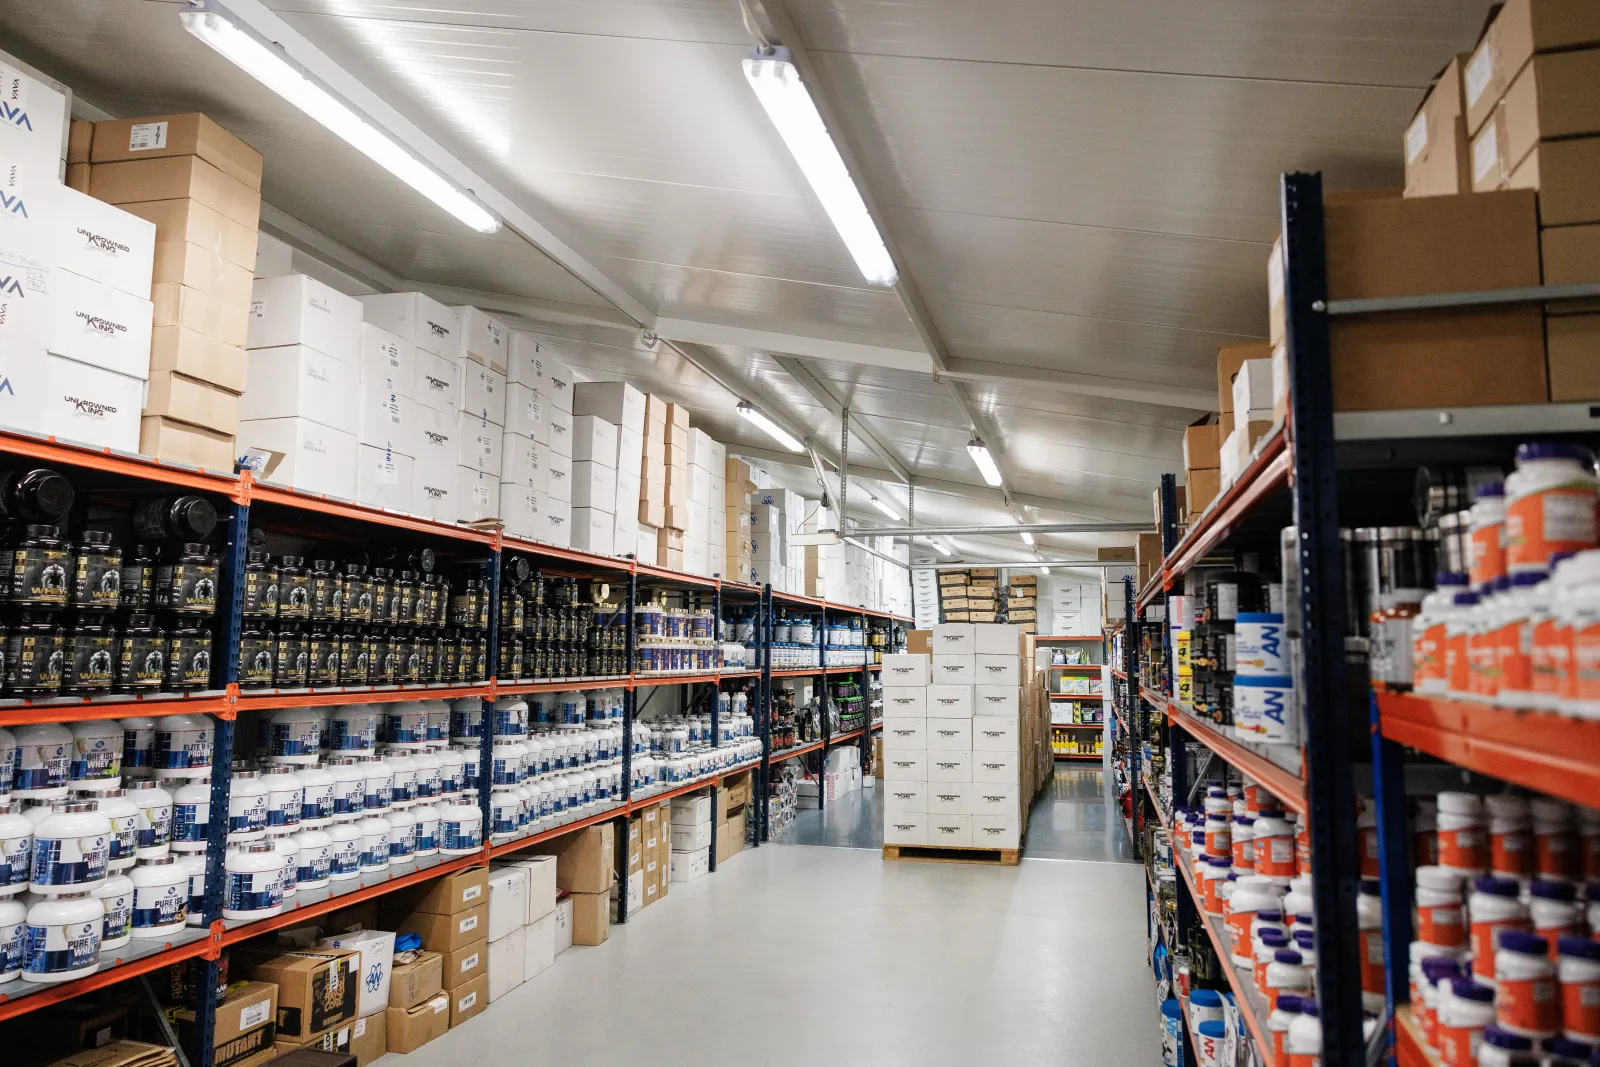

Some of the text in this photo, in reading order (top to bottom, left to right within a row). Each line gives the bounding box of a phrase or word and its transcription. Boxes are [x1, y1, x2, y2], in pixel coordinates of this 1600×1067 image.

[1261, 626, 1281, 659] AN
[1264, 690, 1285, 725] AN
[81, 752, 102, 760] PURE
[82, 852, 101, 862] PURE
[155, 900, 173, 908] PURE
[103, 911, 122, 920] PURE
[68, 939, 89, 950] PURE
